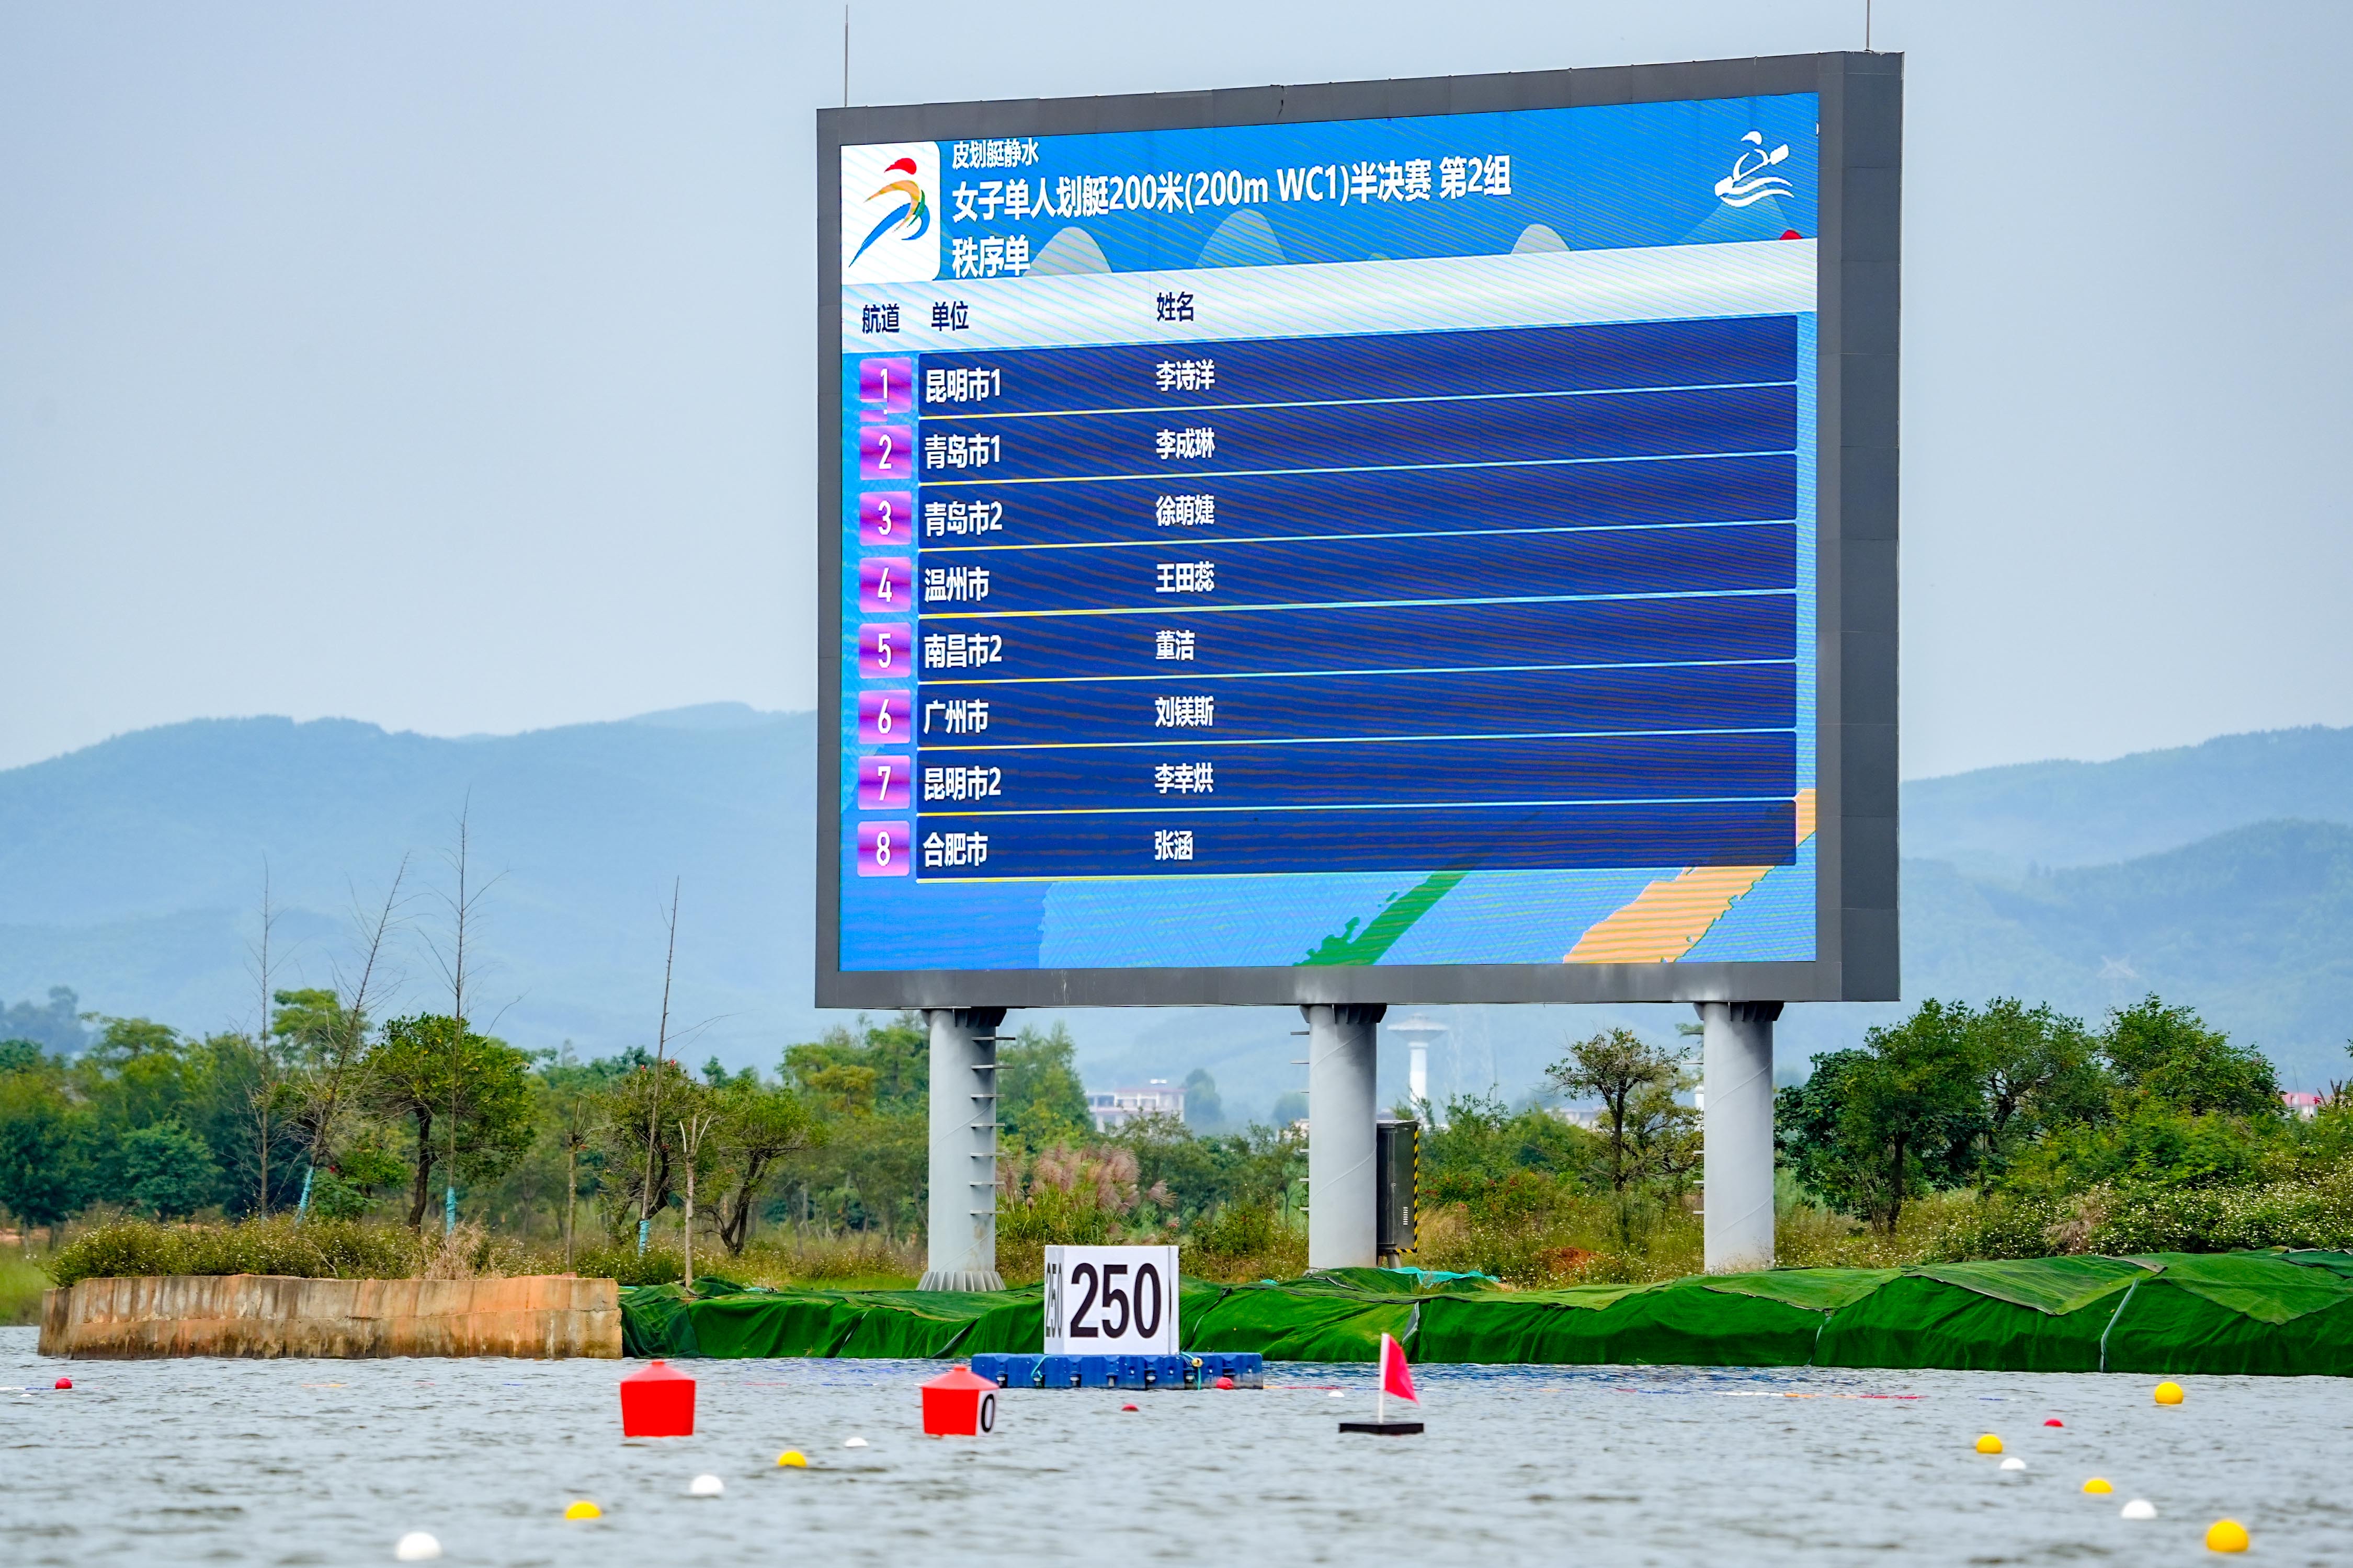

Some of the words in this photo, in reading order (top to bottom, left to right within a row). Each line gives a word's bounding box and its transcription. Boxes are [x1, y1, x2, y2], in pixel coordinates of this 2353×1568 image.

[952, 138, 1039, 169] 皮划艇静水
[952, 169, 1268, 223] 女子单人划艇200米(200m
[1277, 158, 1431, 206] WC1)半决赛
[1439, 154, 1511, 199] 第2组
[952, 234, 1031, 279] 秩序单
[862, 303, 900, 334] 航道
[931, 301, 969, 331] 单位
[1157, 291, 1193, 322] 姓名
[881, 368, 888, 399] 1
[926, 367, 1000, 403] 昆明市1
[1156, 359, 1215, 391] 李诗洋
[879, 434, 892, 470] 2
[925, 432, 999, 469] 青岛市1
[1156, 427, 1215, 460] 李成琳
[878, 500, 891, 535] 3
[925, 500, 1002, 536] 青岛市2
[1156, 494, 1215, 526] 徐萌婕
[878, 567, 892, 602] 4
[925, 566, 990, 602] 温州市
[1156, 561, 1214, 592] 王田蕊
[878, 633, 891, 668] 5
[924, 633, 1002, 668] 南昌市2
[1156, 630, 1195, 660] 董洁
[878, 699, 891, 734] 6
[924, 699, 988, 734] 广州市
[878, 766, 891, 800] 7
[924, 765, 1001, 801] 昆明市2
[877, 831, 890, 866] 8
[923, 831, 988, 867] 合肥市
[1155, 830, 1193, 860] 张涵
[1045, 1262, 1063, 1338] 250
[1070, 1262, 1161, 1338] 250
